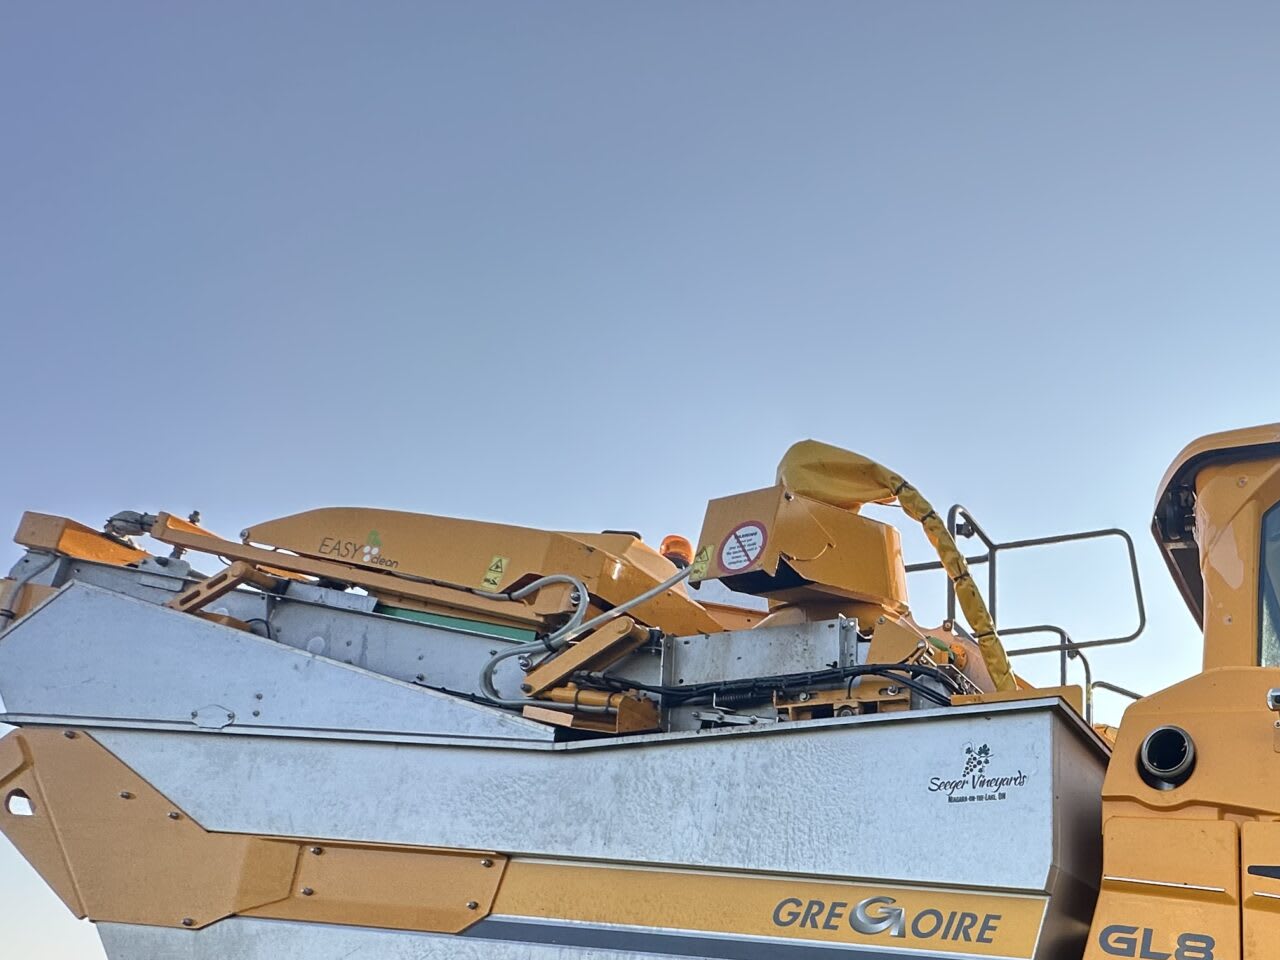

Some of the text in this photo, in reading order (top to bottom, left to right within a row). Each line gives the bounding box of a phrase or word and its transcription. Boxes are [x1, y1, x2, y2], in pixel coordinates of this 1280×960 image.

[318, 537, 364, 559] EASY
[928, 769, 1027, 796] Seeger Vineyards
[772, 896, 1002, 944] GREGOIRE
